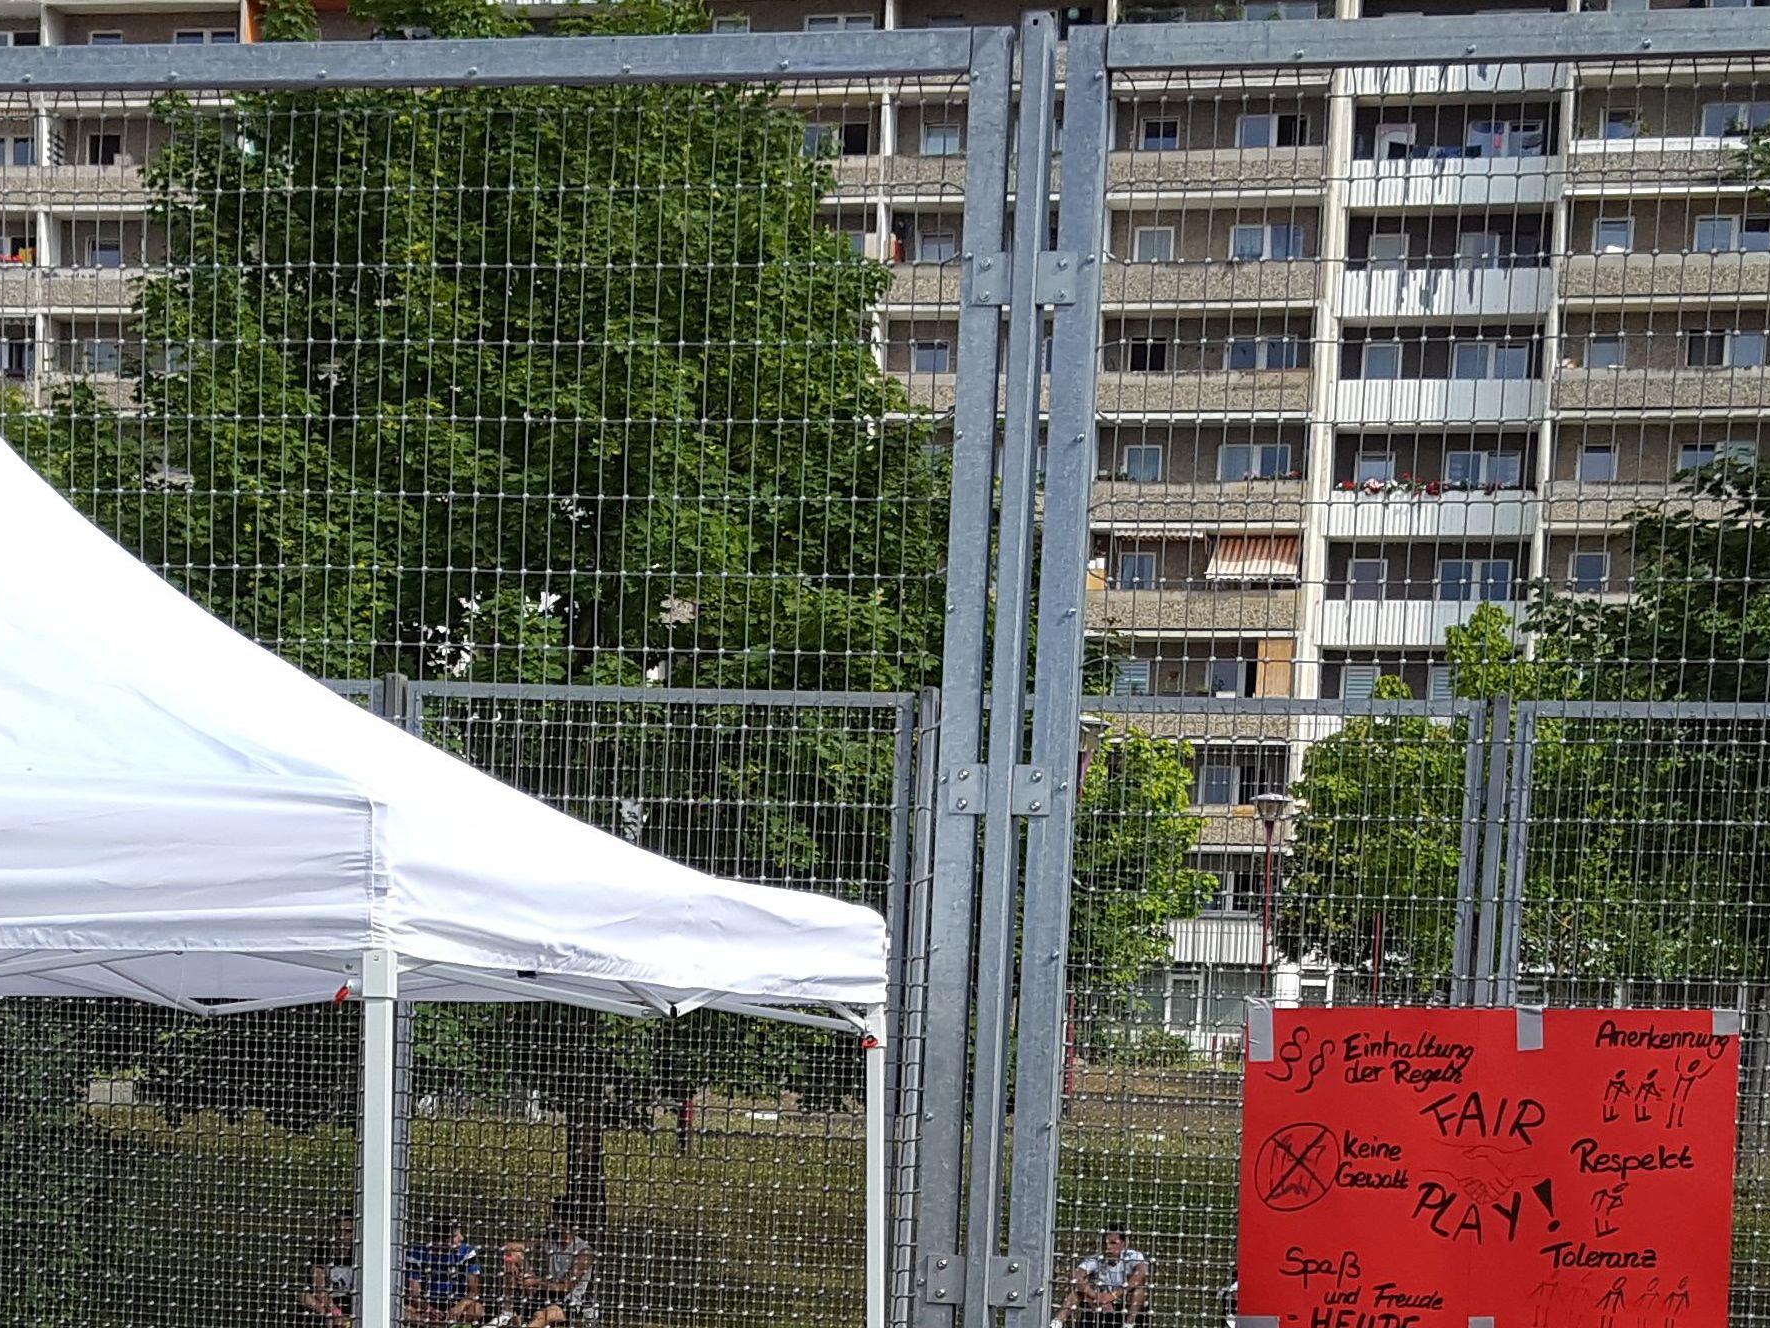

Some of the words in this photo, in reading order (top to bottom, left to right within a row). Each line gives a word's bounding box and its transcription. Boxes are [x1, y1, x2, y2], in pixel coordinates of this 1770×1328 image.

[1343, 1031, 1475, 1071] Einhaltung
[1595, 1020, 1729, 1060] Anerkennung
[1344, 1061, 1385, 1084] der
[1419, 1092, 1546, 1146] FAIR
[1570, 1138, 1695, 1181] Respekt
[1279, 1246, 1361, 1290] Spaß
[1540, 1242, 1657, 1269] Toleranz
[1324, 1286, 1361, 1305] und
[1373, 1282, 1443, 1310] Freude
